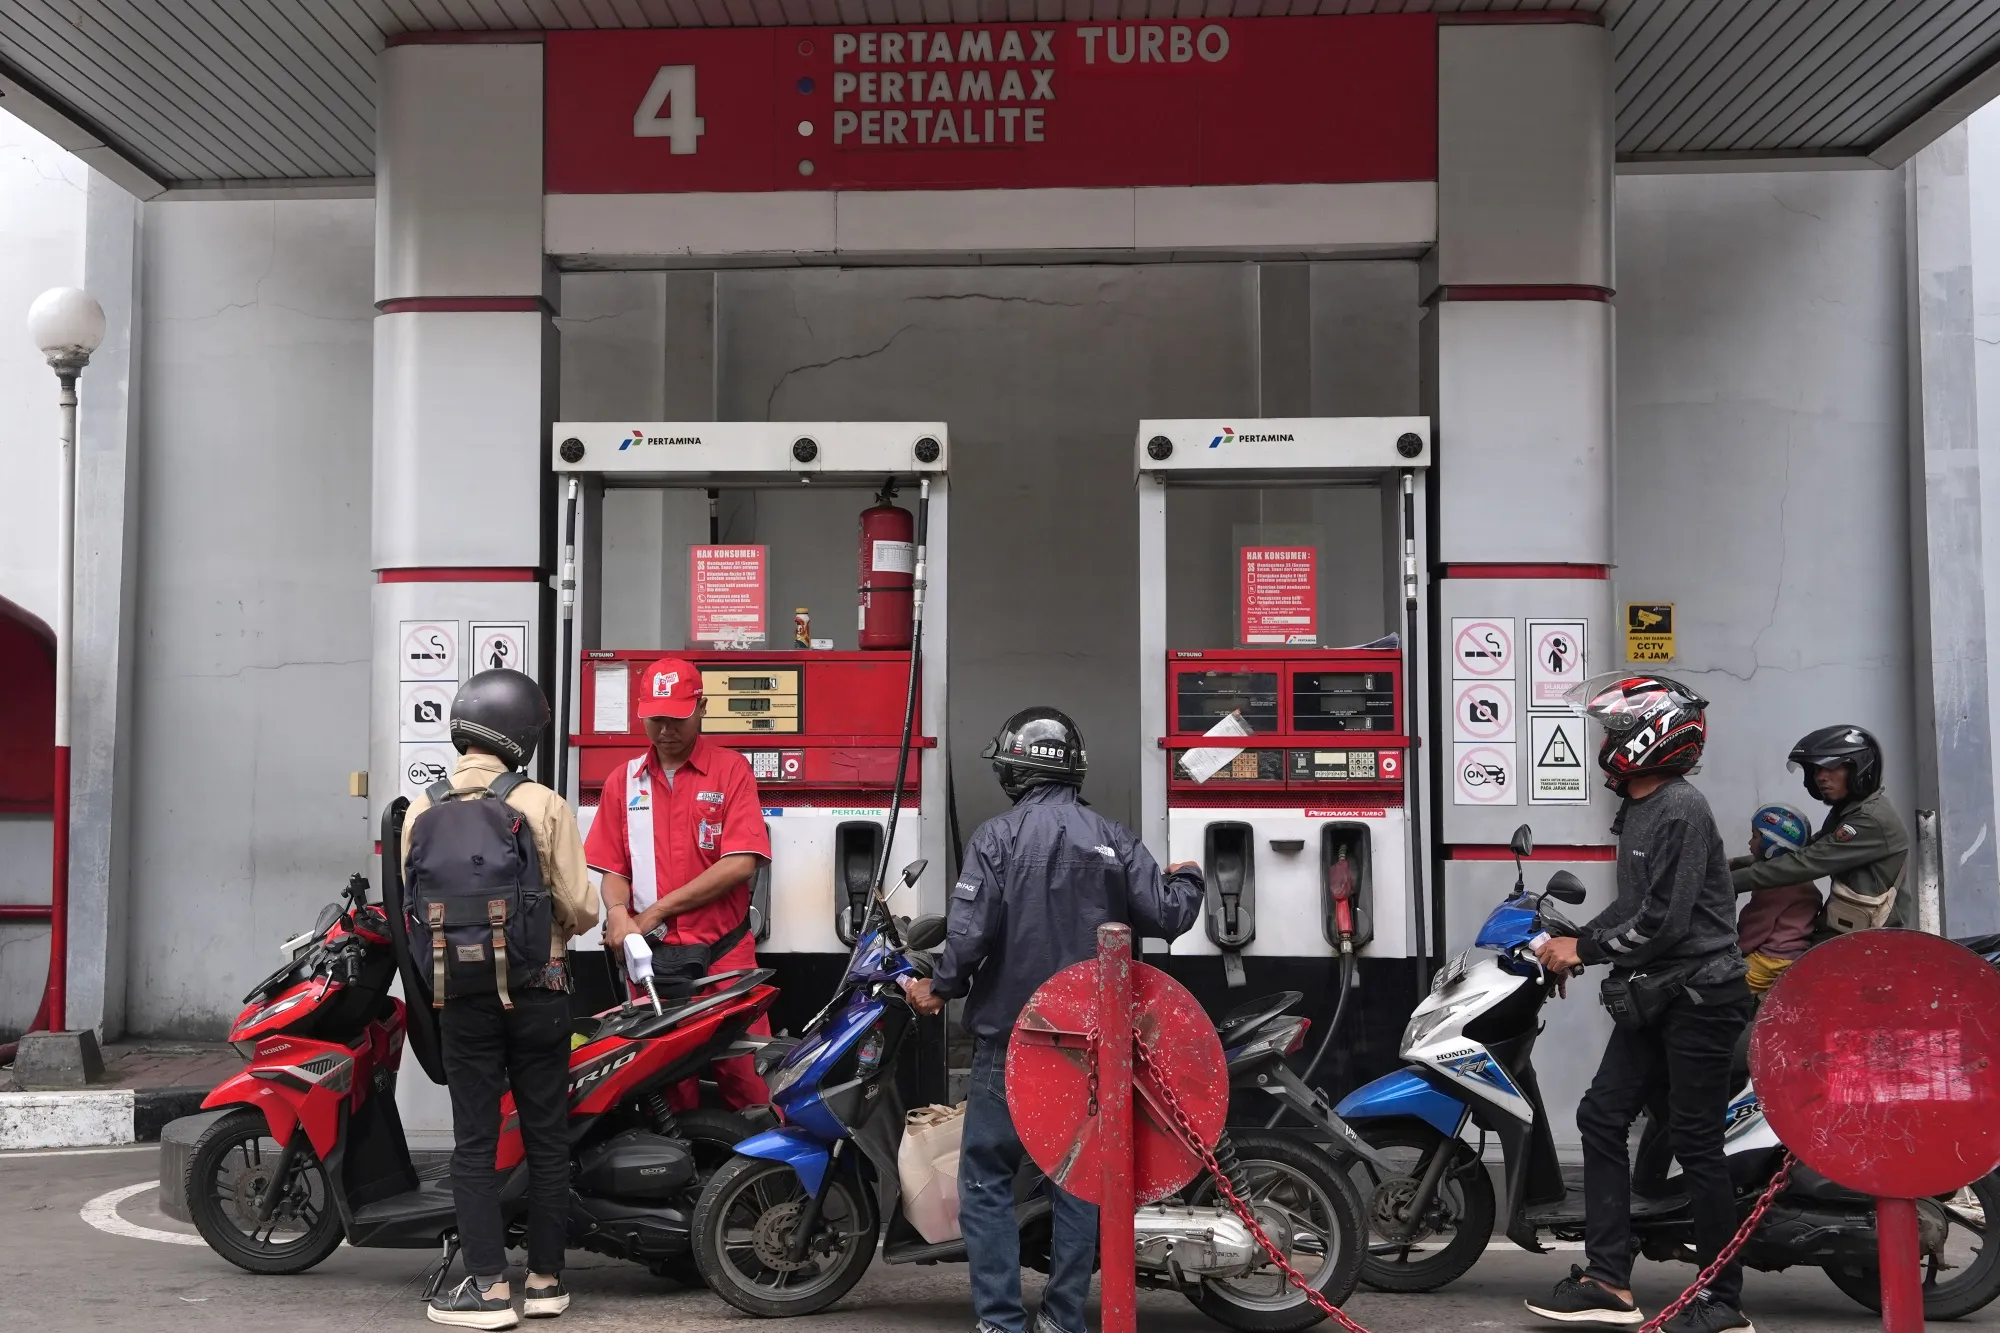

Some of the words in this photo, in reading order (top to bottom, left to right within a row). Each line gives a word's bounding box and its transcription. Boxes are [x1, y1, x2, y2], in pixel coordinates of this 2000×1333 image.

[833, 30, 1055, 64] PERTAMAX
[1077, 24, 1230, 64] TURBO
[833, 69, 1055, 103] PERTAMAX
[633, 64, 705, 155] 4
[833, 108, 1045, 144] PERTALITE
[648, 437, 702, 446] PERTAMINA
[1239, 434, 1295, 443] PERTAMINA
[697, 550, 712, 558] HAK
[1247, 552, 1262, 560] HAK
[411, 769, 426, 777] ON
[1467, 770, 1483, 778] ON
[260, 1043, 292, 1056] HONDA
[1436, 1048, 1475, 1060] HONDA
[568, 1051, 637, 1092] RIO
